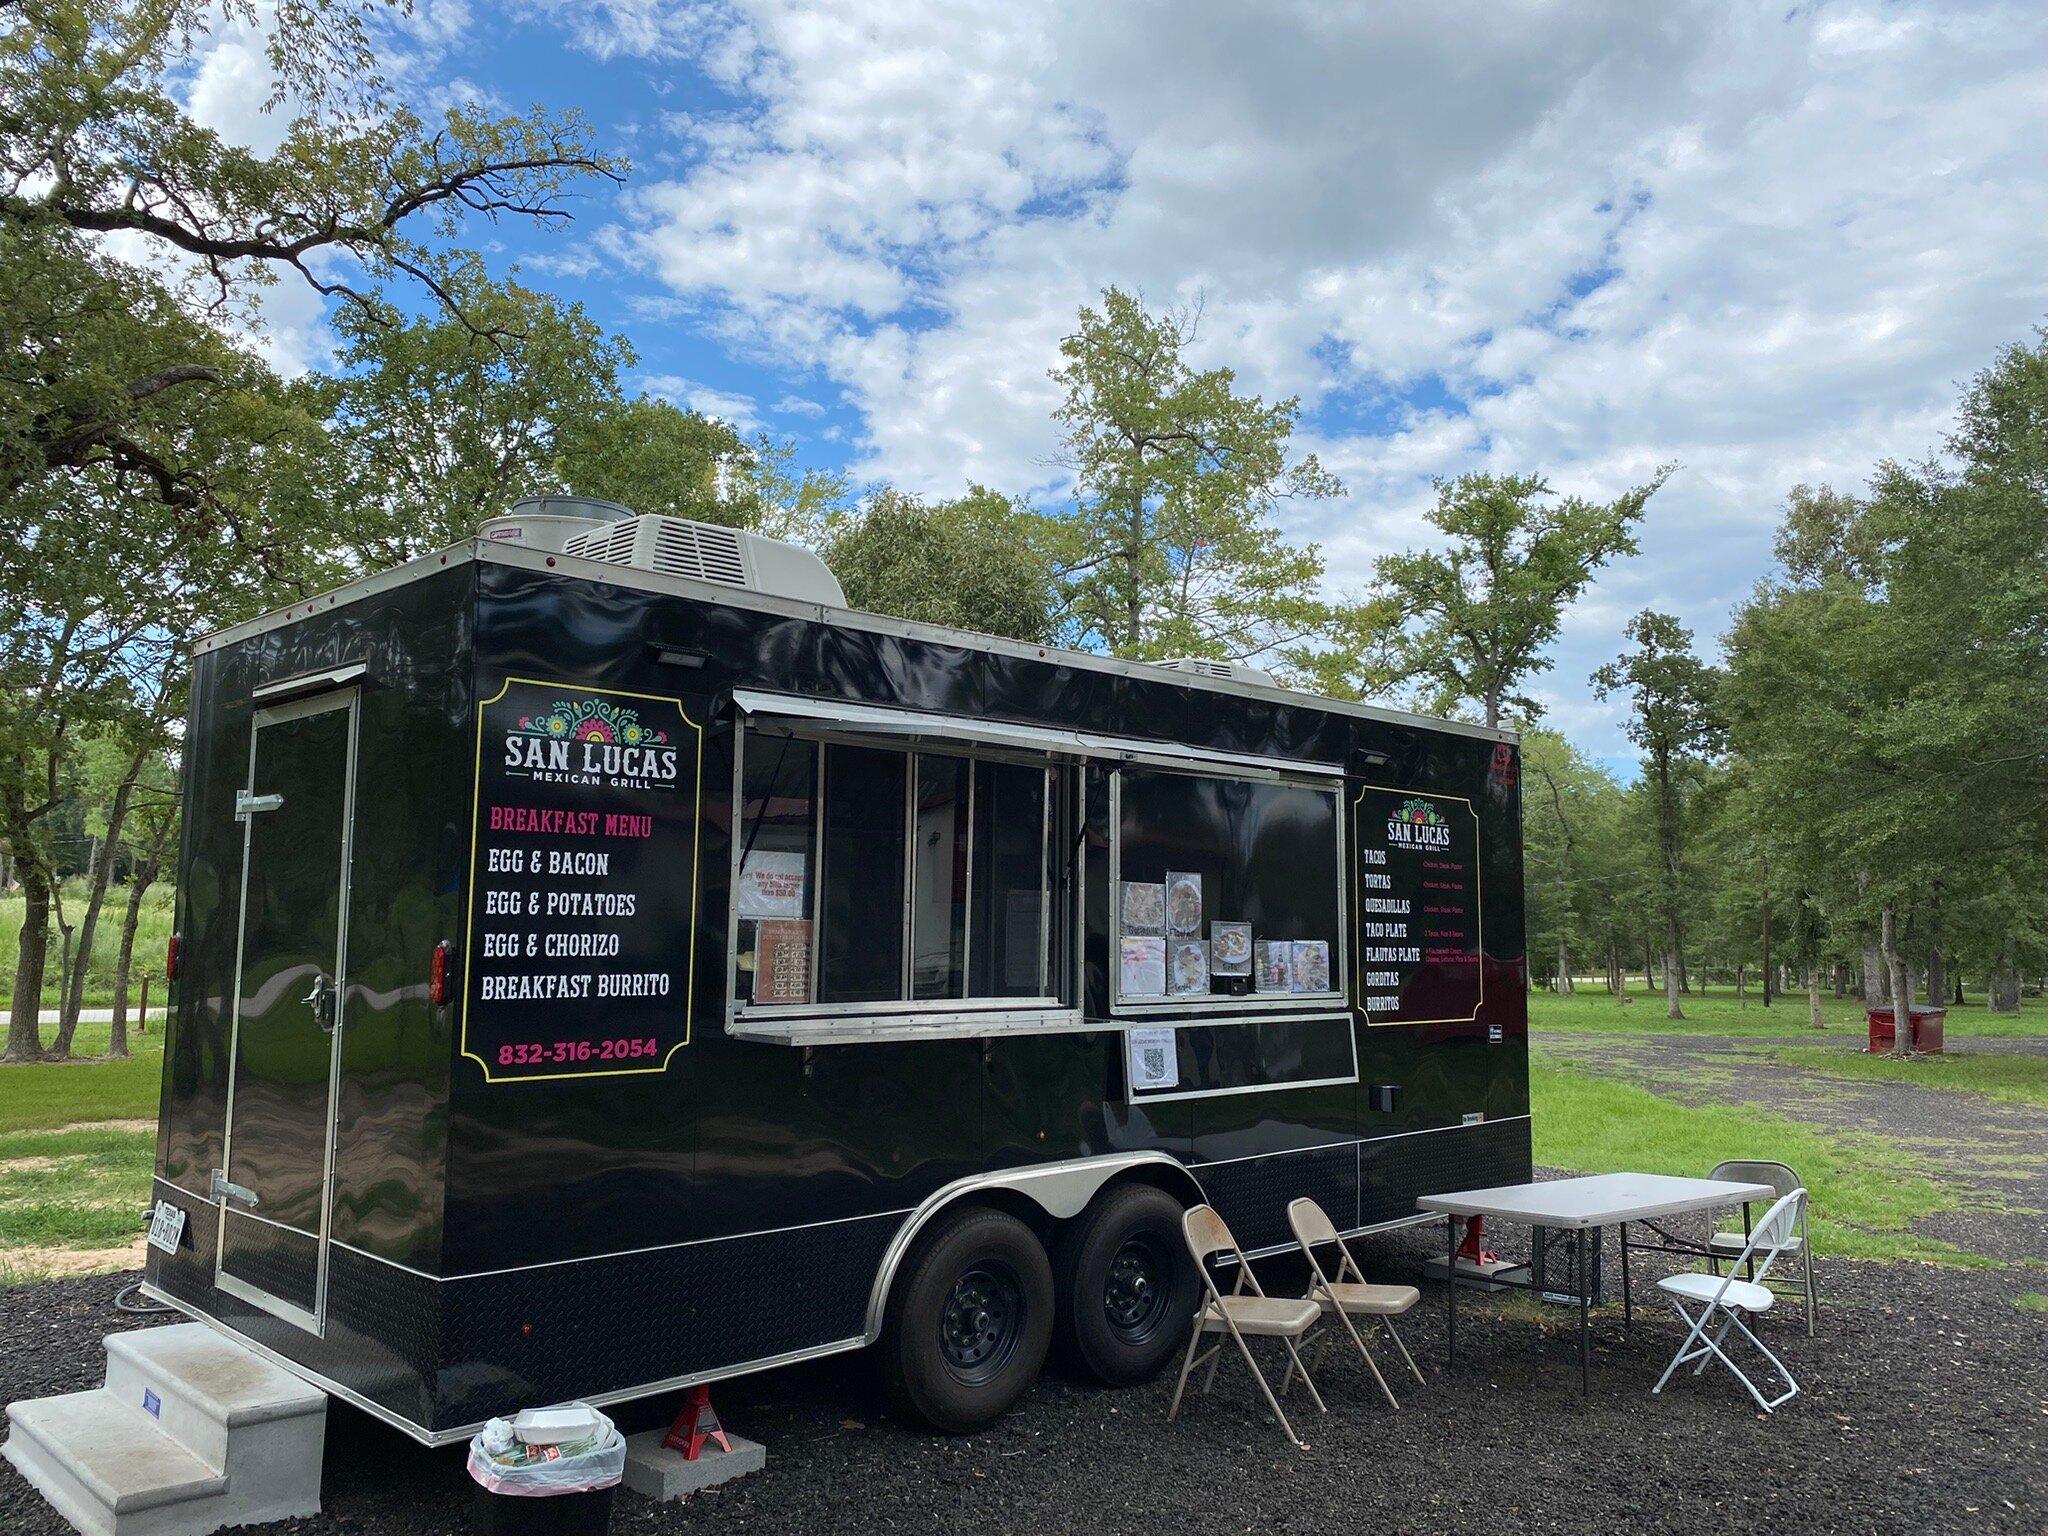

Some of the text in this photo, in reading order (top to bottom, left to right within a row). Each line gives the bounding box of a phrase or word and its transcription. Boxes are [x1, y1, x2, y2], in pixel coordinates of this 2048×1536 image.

[505, 736, 678, 780] SAN LUCAS
[533, 772, 651, 790] MEXICAN GRILL
[490, 806, 652, 838] BREAKFAST MENU
[1388, 822, 1450, 845] SAN LUCAS
[1398, 842, 1423, 850] MEXICAN
[487, 848, 609, 876] EGG & BACON
[1364, 849, 1386, 865] TACOS
[1365, 873, 1391, 889] TORTAS
[485, 891, 636, 917] EGG & POTATOES
[1365, 898, 1410, 914] QUESADILLAS
[1366, 922, 1407, 938] TACO PLATE
[483, 933, 620, 958] EGG & CHORIZO
[1366, 947, 1420, 962] FLAUTAS PLATE
[481, 973, 670, 1001] BREAKFAST BURRITO
[1366, 972, 1399, 987] GORDITAS
[1366, 996, 1399, 1011] BURRITOS
[498, 1038, 658, 1066] 832-316-2054
